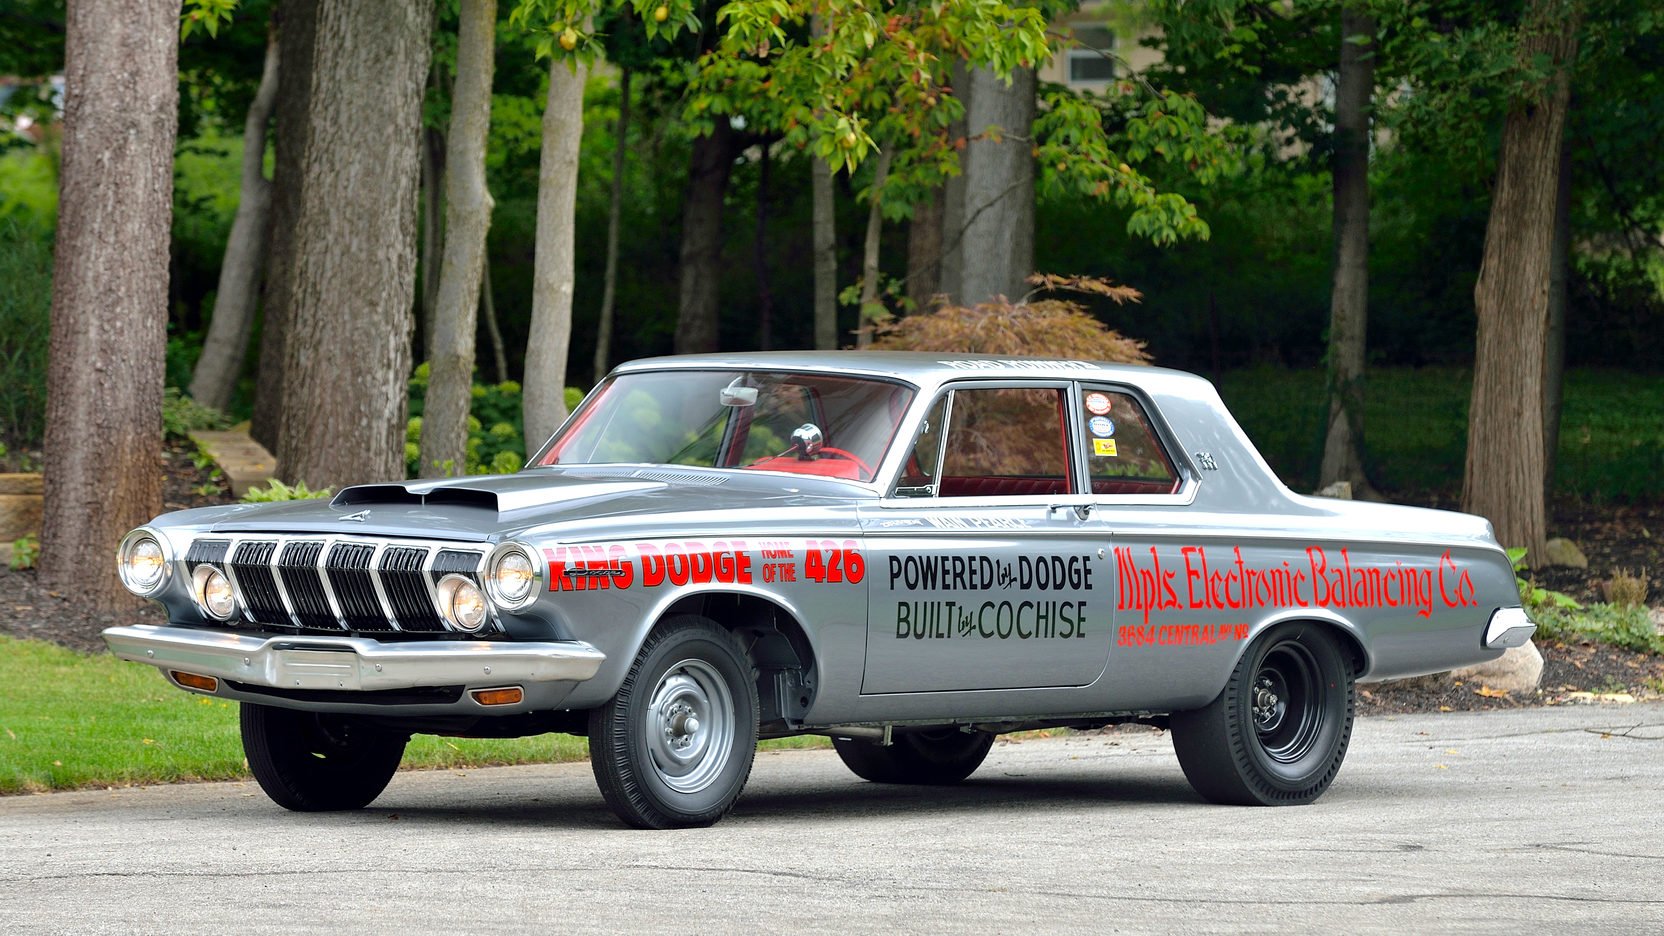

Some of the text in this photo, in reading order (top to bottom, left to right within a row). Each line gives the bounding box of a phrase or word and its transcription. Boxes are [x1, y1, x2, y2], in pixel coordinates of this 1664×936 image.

[542, 540, 753, 592] KING DODGE
[758, 541, 795, 560] HOME
[804, 539, 865, 585] 426
[762, 562, 797, 583] OF THE
[889, 555, 1093, 590] POWERED by DODGE
[1114, 545, 1478, 624] Mpls. Electronic Balancing Co.
[896, 600, 1087, 640] BUILT by COCHISE
[1117, 624, 1157, 648] 3684
[1158, 623, 1217, 646] CENTRAL
